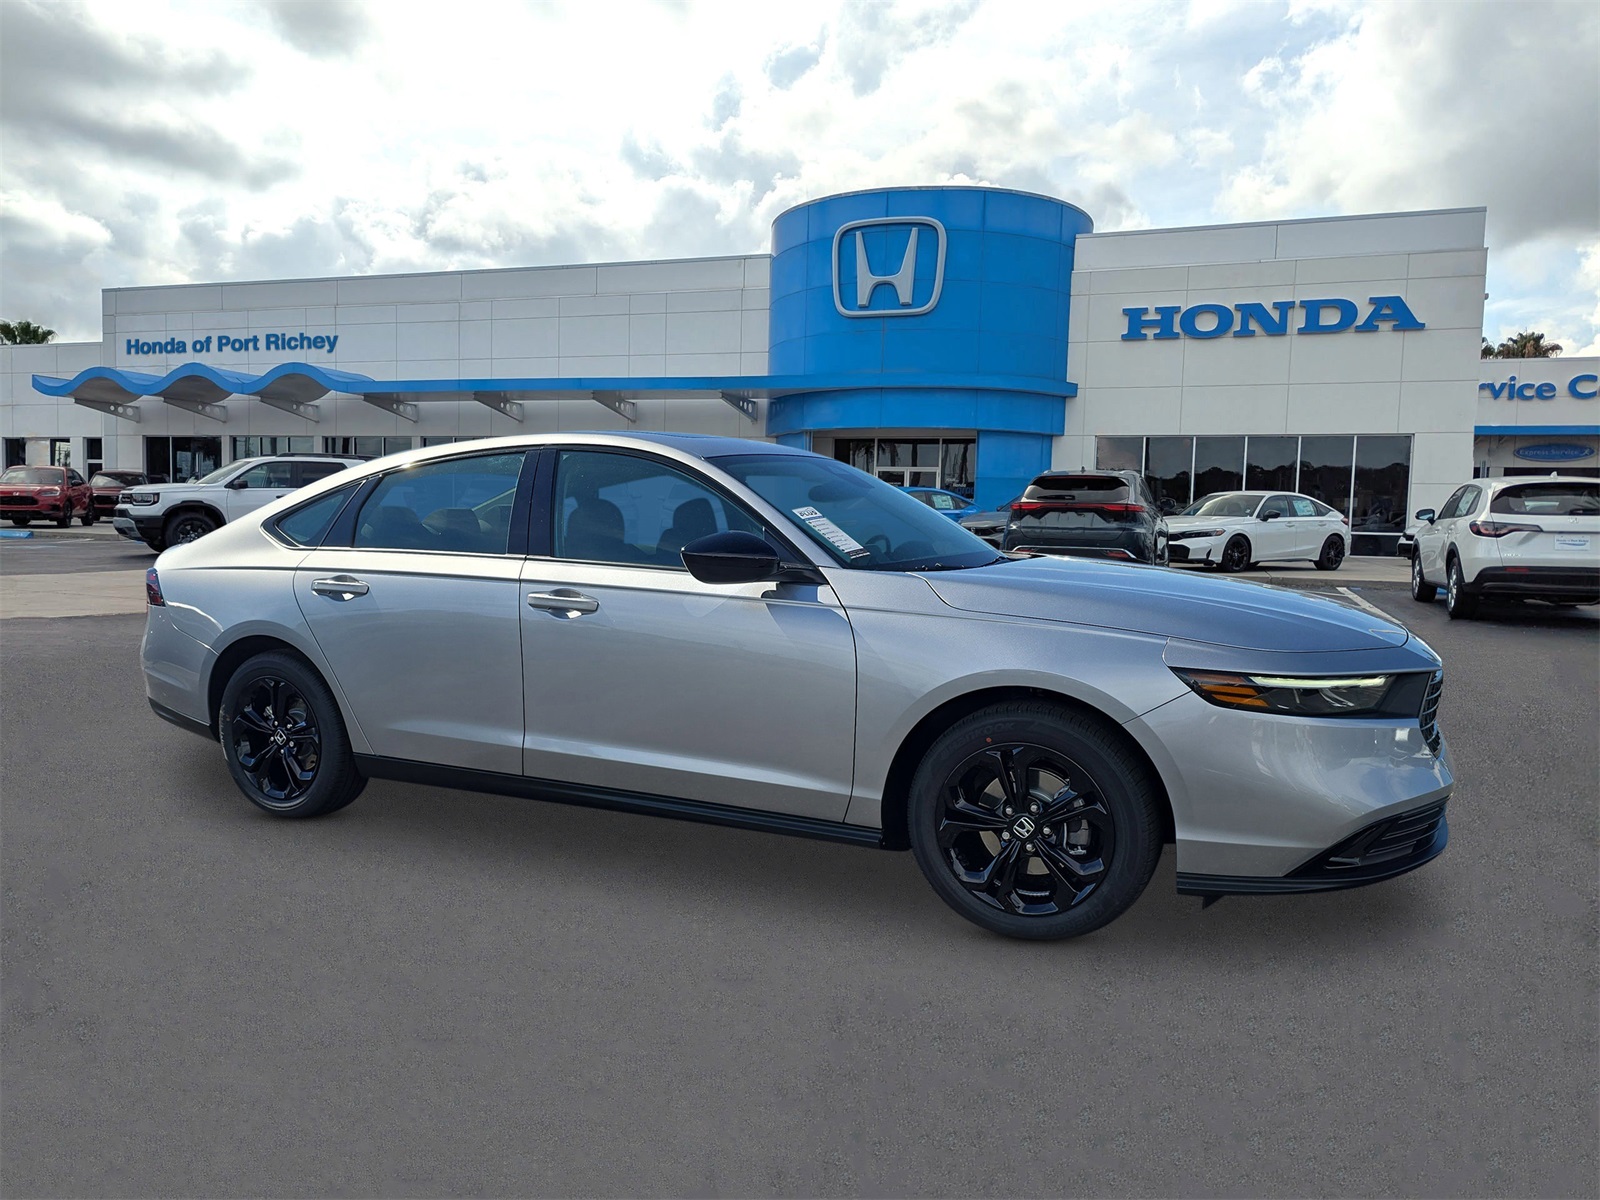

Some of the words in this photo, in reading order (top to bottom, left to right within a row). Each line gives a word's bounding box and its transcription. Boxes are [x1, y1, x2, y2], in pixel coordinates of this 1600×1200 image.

[1120, 295, 1426, 343] HONDA
[126, 337, 187, 355] Honda
[191, 335, 212, 353] of
[217, 335, 260, 352] Port
[265, 332, 339, 354] Richey
[1567, 373, 1600, 400] C
[1519, 448, 1549, 457] Express
[1550, 448, 1580, 456] Service
